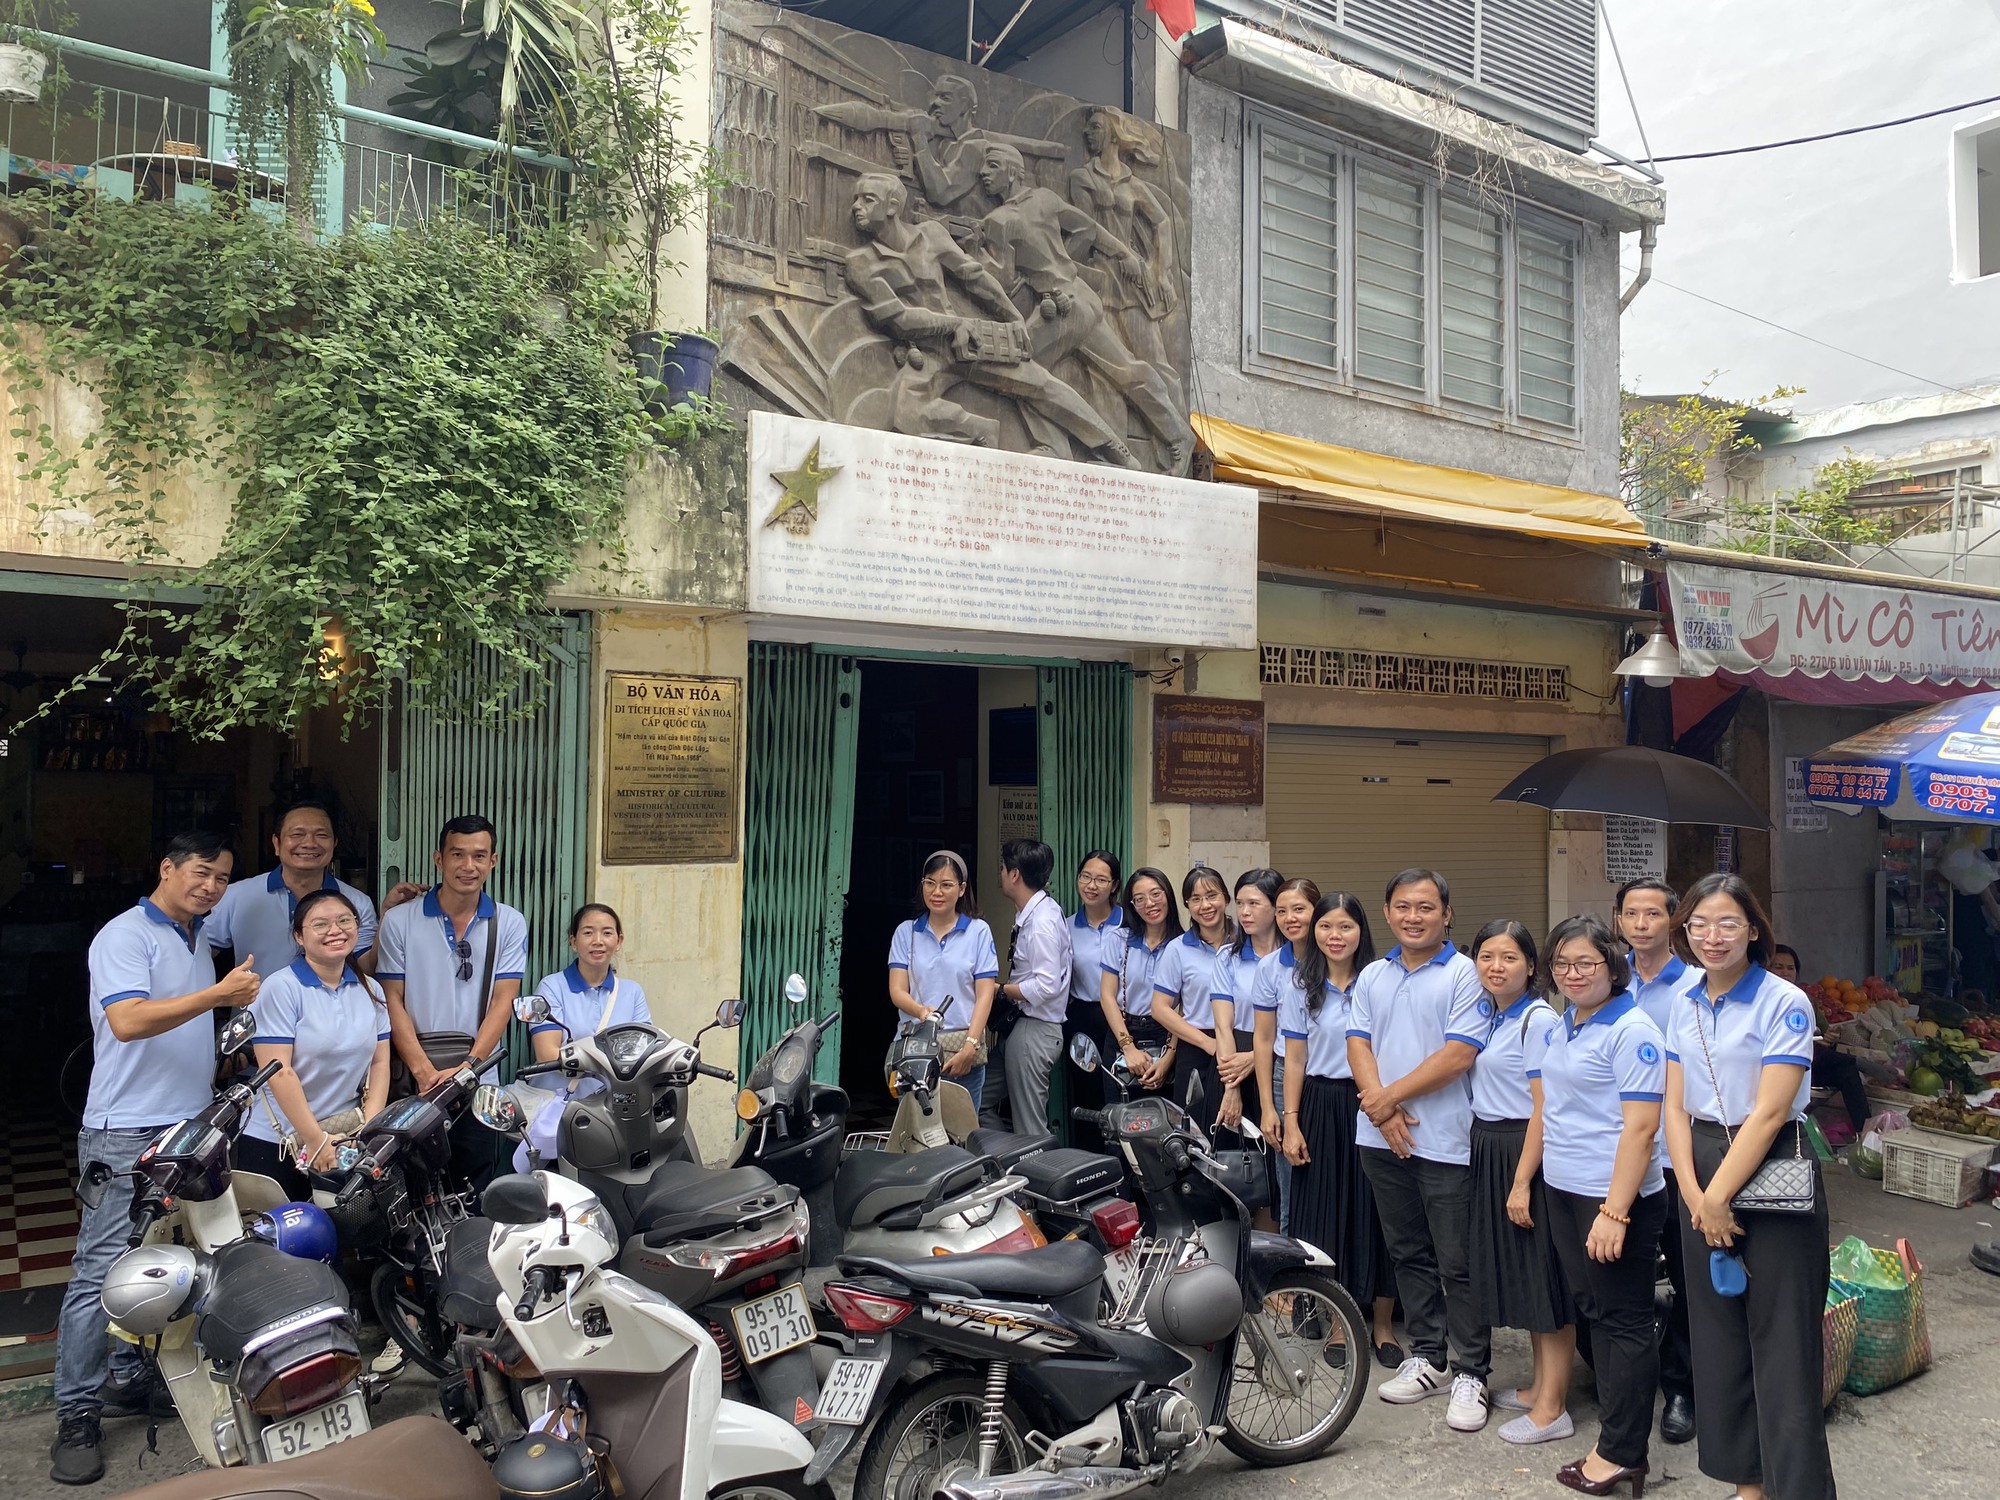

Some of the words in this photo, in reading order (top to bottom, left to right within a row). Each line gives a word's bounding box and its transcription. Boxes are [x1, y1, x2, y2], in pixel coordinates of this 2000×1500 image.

[1796, 591, 1859, 645] Mì
[1868, 593, 1914, 648] Cô
[627, 683, 648, 700] BỘ
[653, 684, 684, 700] VĂN
[690, 685, 721, 701] HÓA
[615, 704, 625, 714] DI
[628, 703, 650, 715] TÍCH
[692, 706, 711, 718] VĂN
[713, 706, 732, 718] HÓA
[641, 716, 660, 727] CẤP
[690, 719, 707, 729] GIA
[1842, 774, 1856, 785] 00
[1858, 775, 1874, 787] 44
[1876, 776, 1889, 788] 77
[617, 789, 665, 798] MINISTRY
[668, 790, 681, 798] OF
[684, 789, 727, 798] CULTURE
[1856, 787, 1872, 799] 44
[1873, 789, 1887, 801] 77
[1929, 782, 1996, 801] 0903.
[1928, 795, 1994, 814] 0707.
[1019, 1148, 1044, 1161] HONDA
[1076, 1170, 1108, 1185] HONDA
[282, 1207, 304, 1229] ila
[268, 1306, 323, 1331] HONDA
[745, 1292, 798, 1330] 95-B2
[746, 1314, 812, 1358] 097.30
[818, 1389, 867, 1420] 147.74
[278, 1403, 352, 1456] 52-H3
